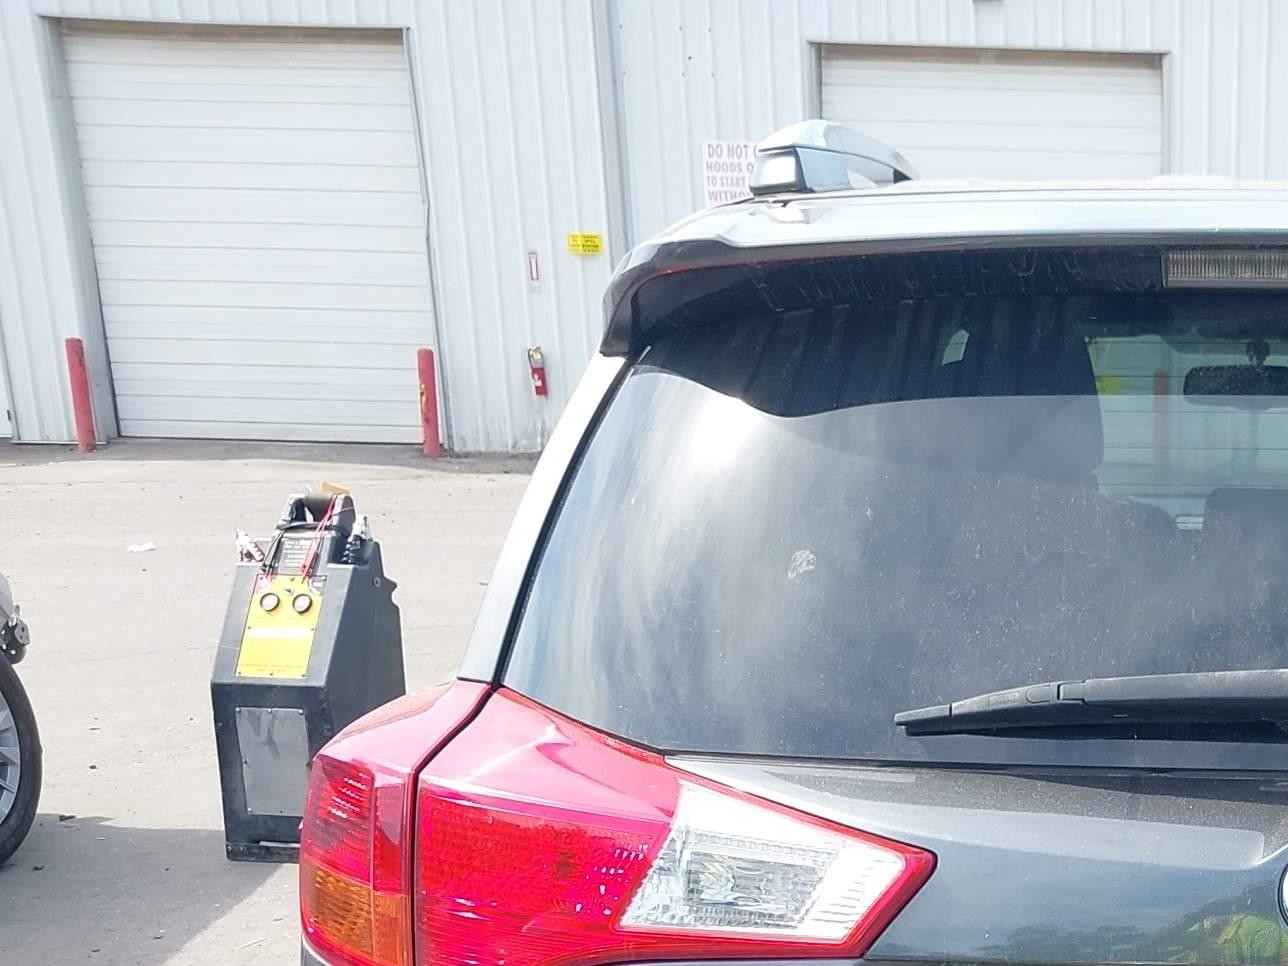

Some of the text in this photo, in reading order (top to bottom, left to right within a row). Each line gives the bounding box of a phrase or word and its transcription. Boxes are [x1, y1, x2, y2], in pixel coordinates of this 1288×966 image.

[707, 144, 723, 159] DO
[727, 144, 748, 160] NOT
[706, 161, 743, 174] HOODS
[706, 175, 718, 188] TO
[719, 175, 746, 188] START
[707, 190, 751, 202] WITHO
